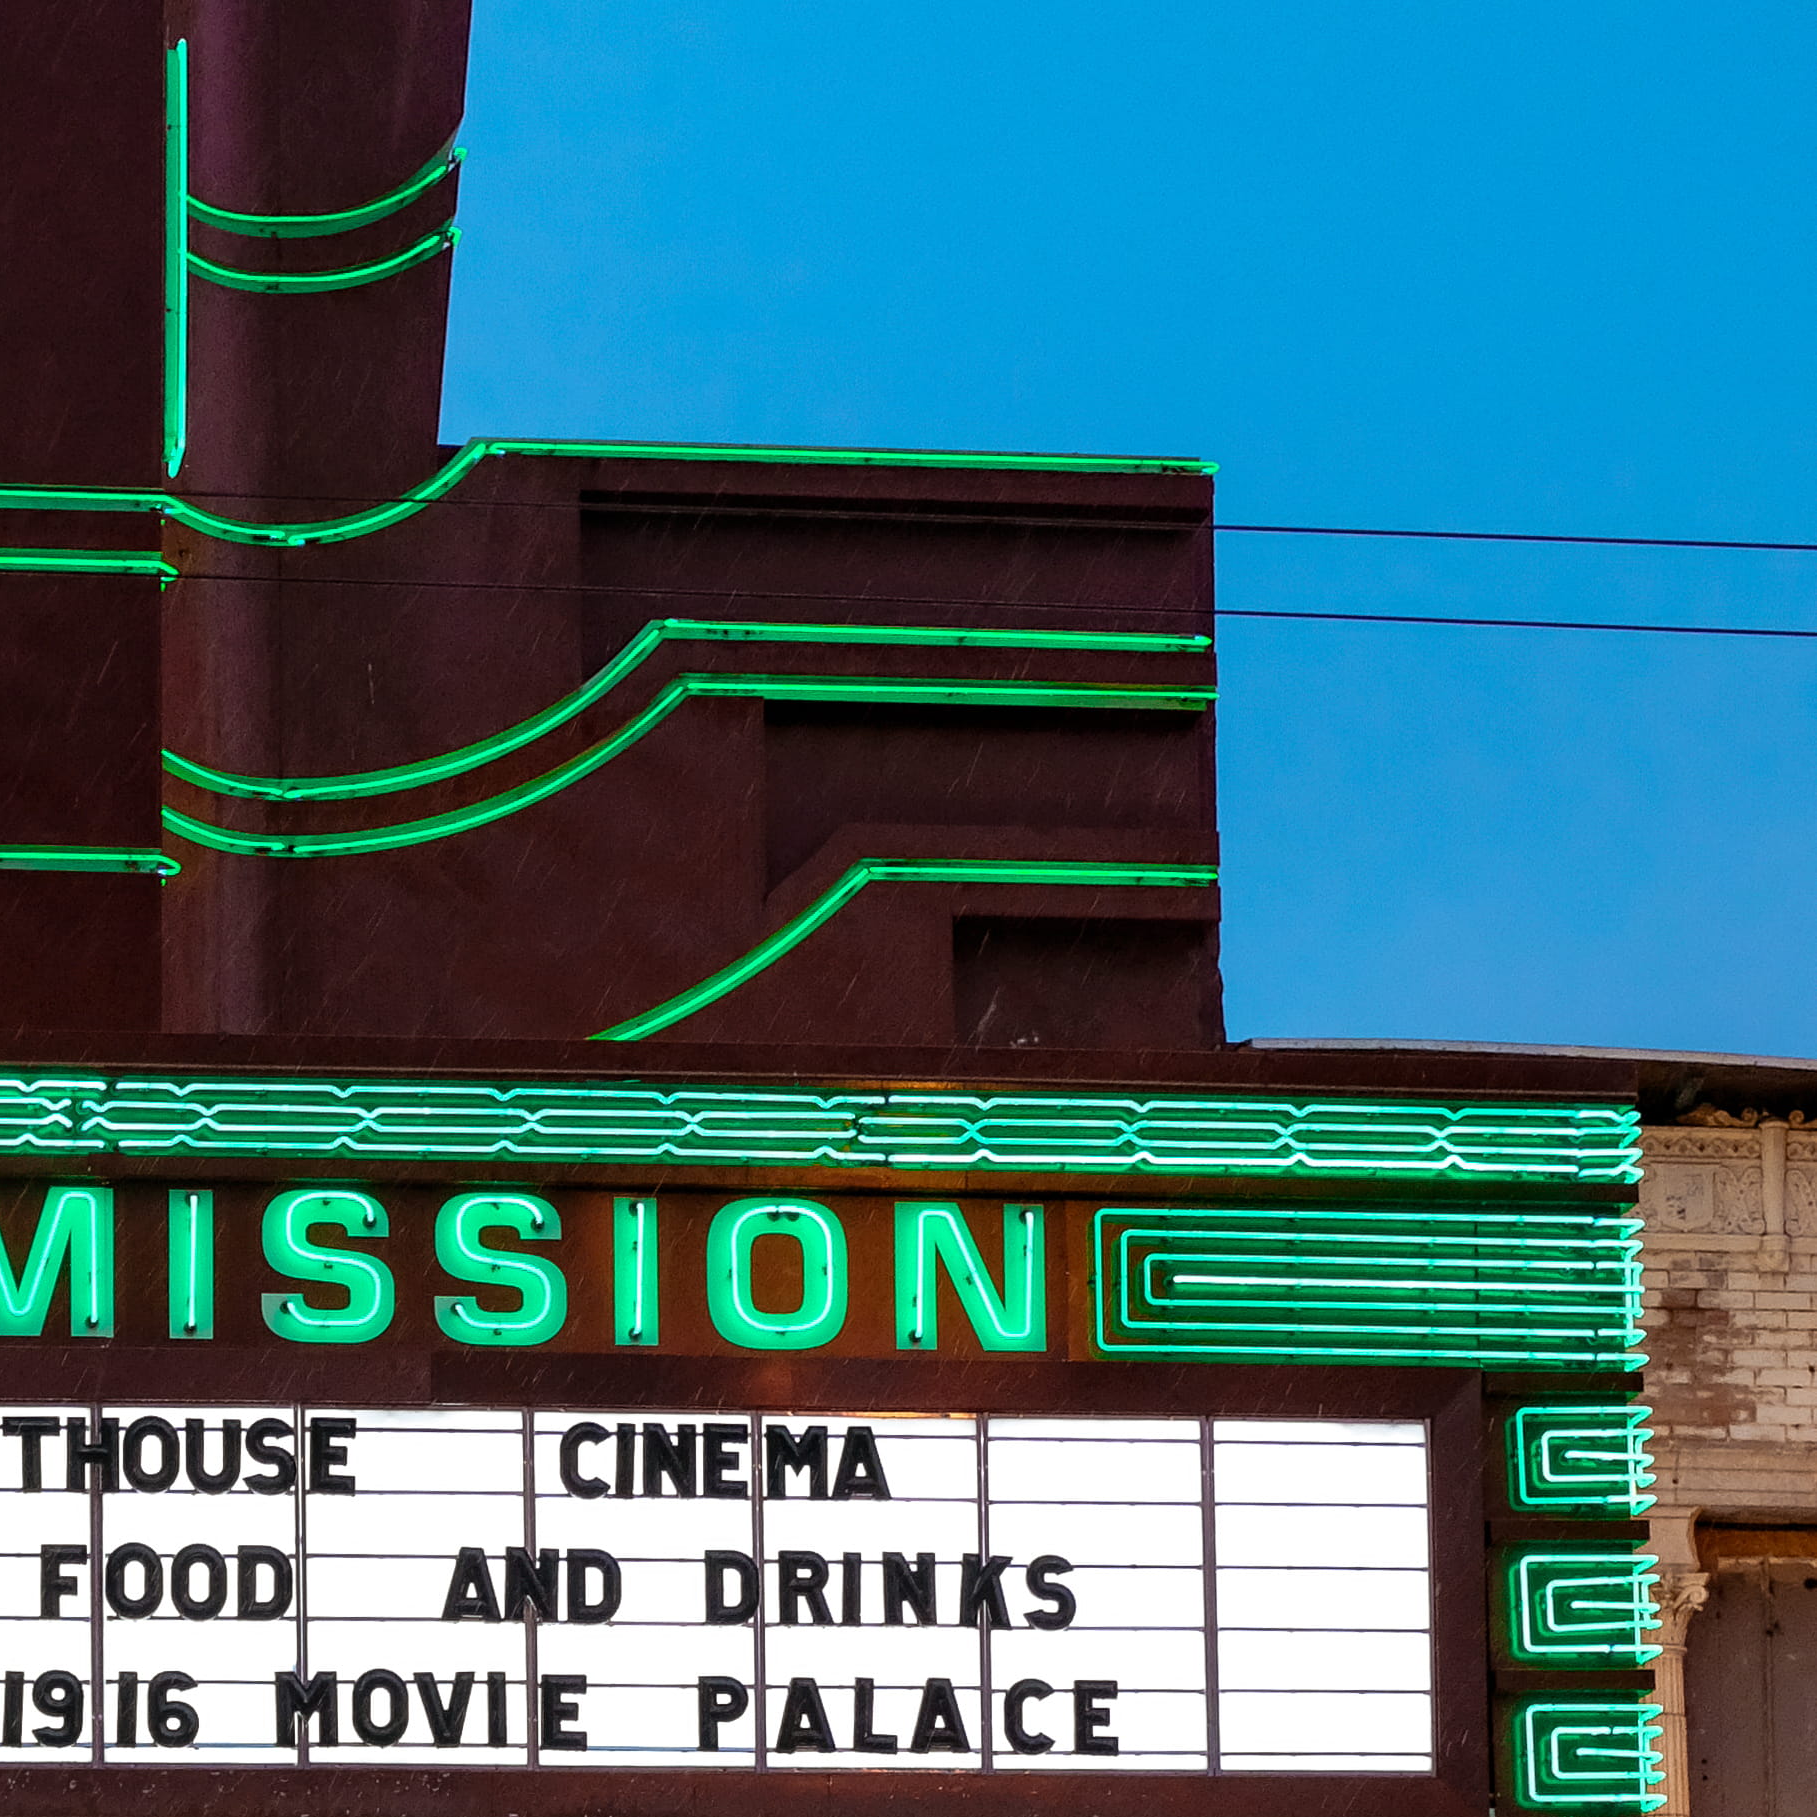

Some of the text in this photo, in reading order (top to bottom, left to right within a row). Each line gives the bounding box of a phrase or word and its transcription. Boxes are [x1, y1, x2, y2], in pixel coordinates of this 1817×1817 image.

[559, 1421, 892, 1502] CINEMA
[40, 1542, 294, 1623] FOOD
[441, 1546, 623, 1625] AND
[703, 1549, 1079, 1633] DRINKS
[1, 1669, 201, 1750] 1916
[275, 1670, 588, 1752] MOVIE
[696, 1676, 1121, 1757] PALACE
